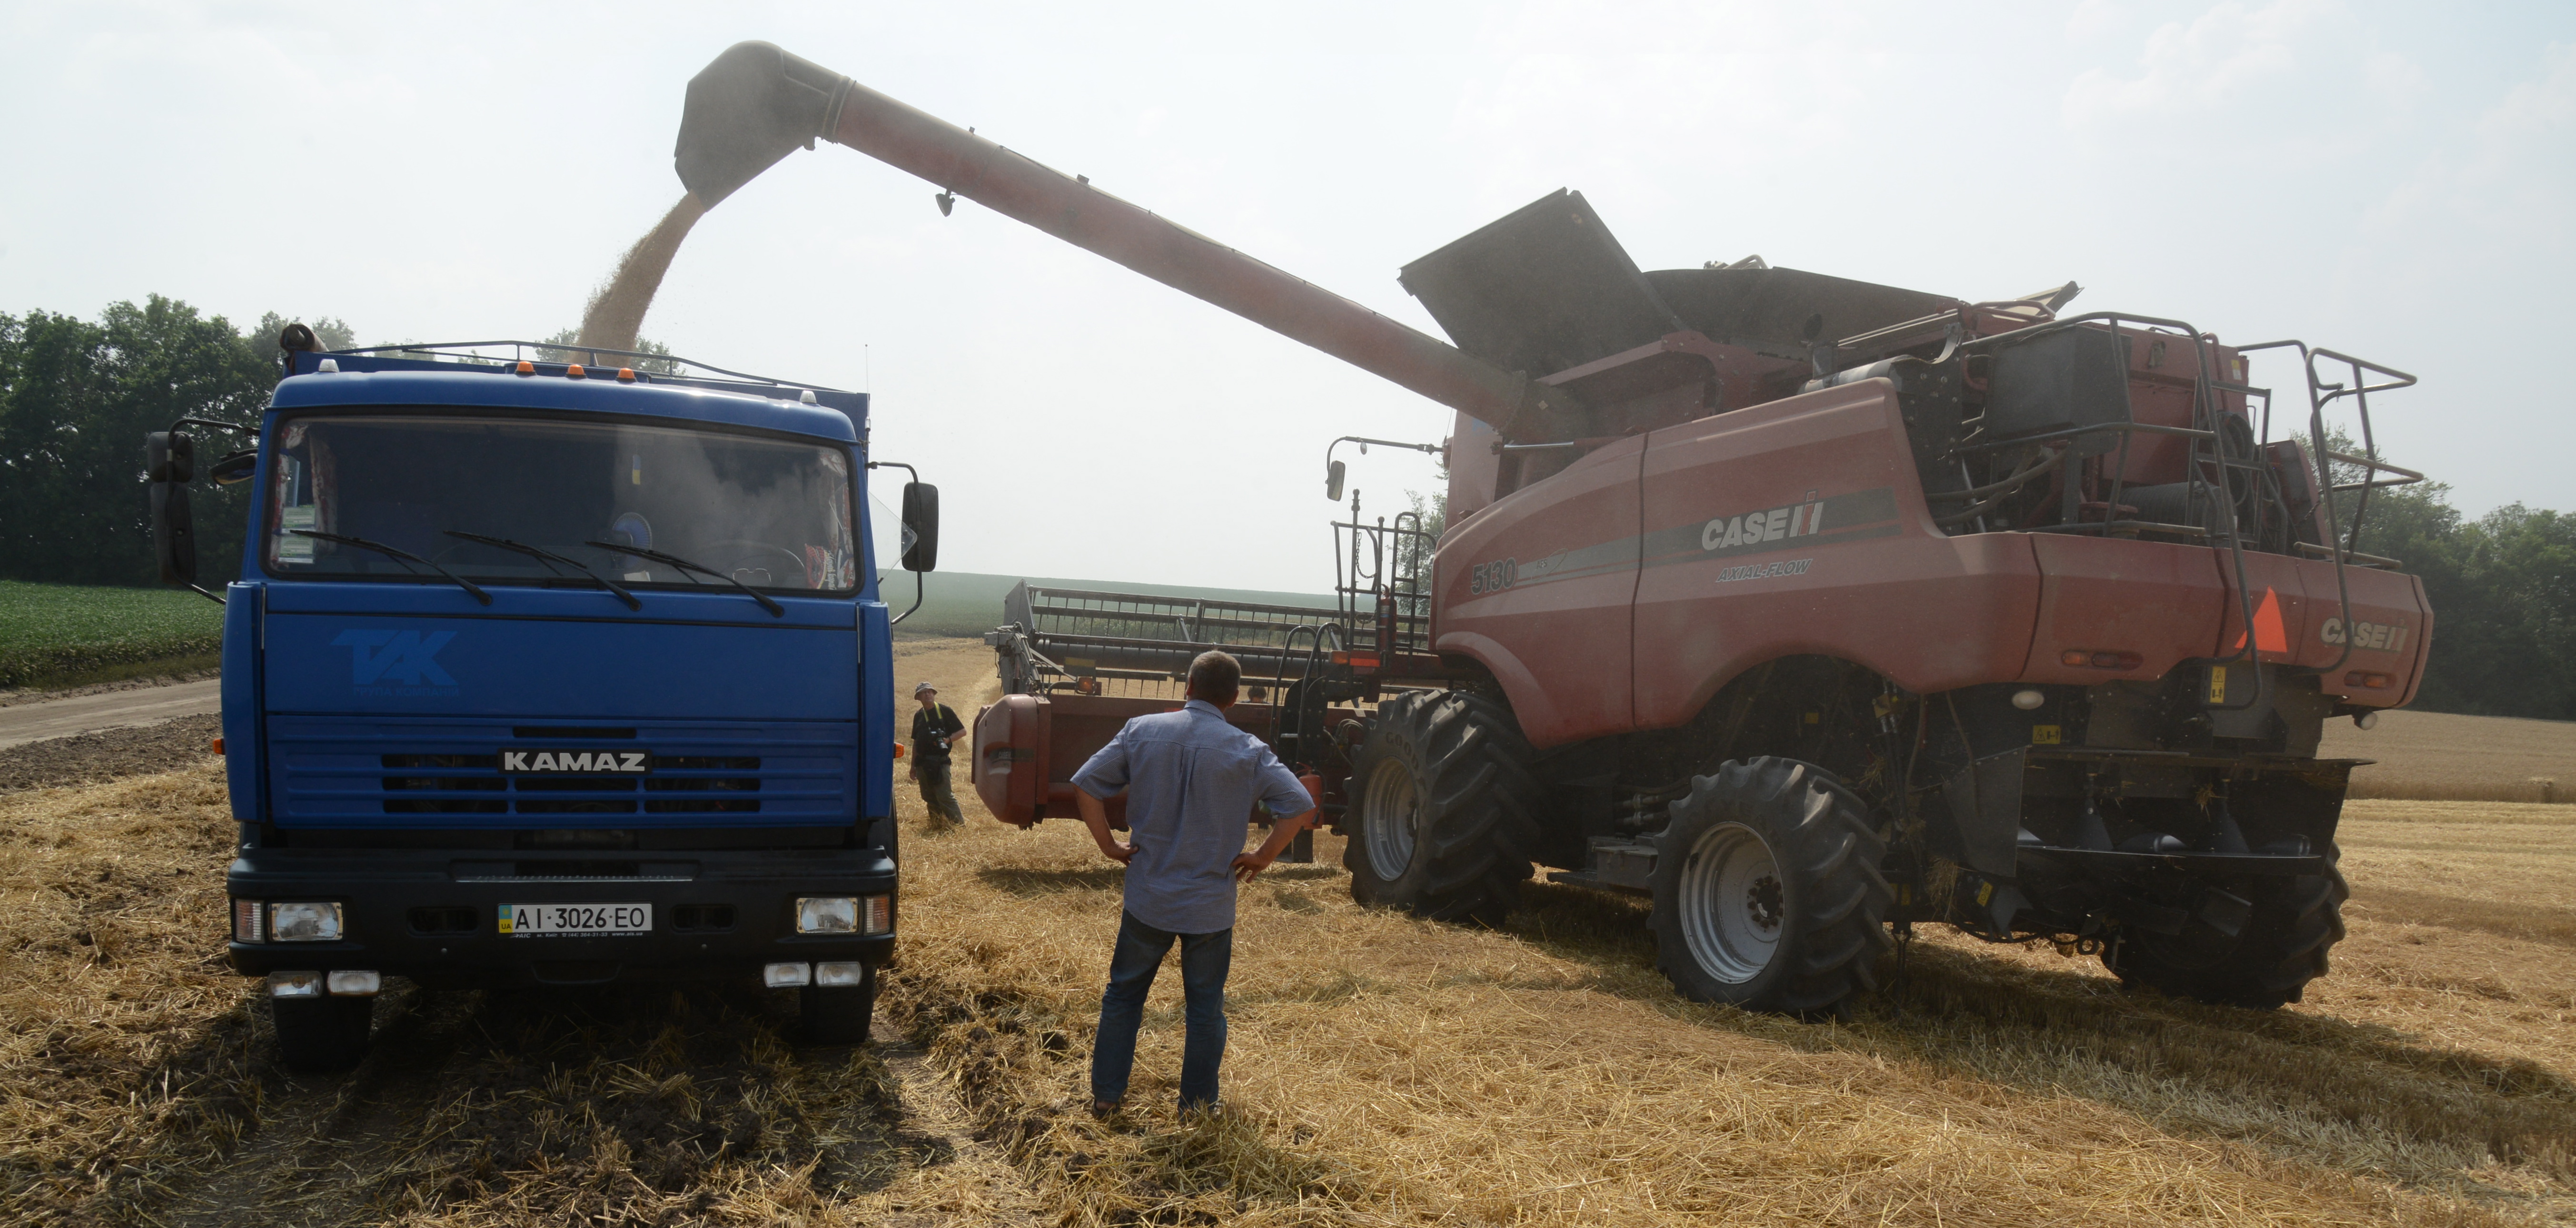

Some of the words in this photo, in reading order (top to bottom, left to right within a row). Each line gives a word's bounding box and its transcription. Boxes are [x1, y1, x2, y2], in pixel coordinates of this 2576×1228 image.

[1536, 559, 1547, 570] AFS
[1715, 558, 1813, 583] AXIAL-FLOW
[1471, 557, 1517, 595] 5130
[354, 688, 392, 696] ГРУПА
[396, 687, 459, 697] КОМПАНІЙ
[505, 752, 645, 771] KAMAZ
